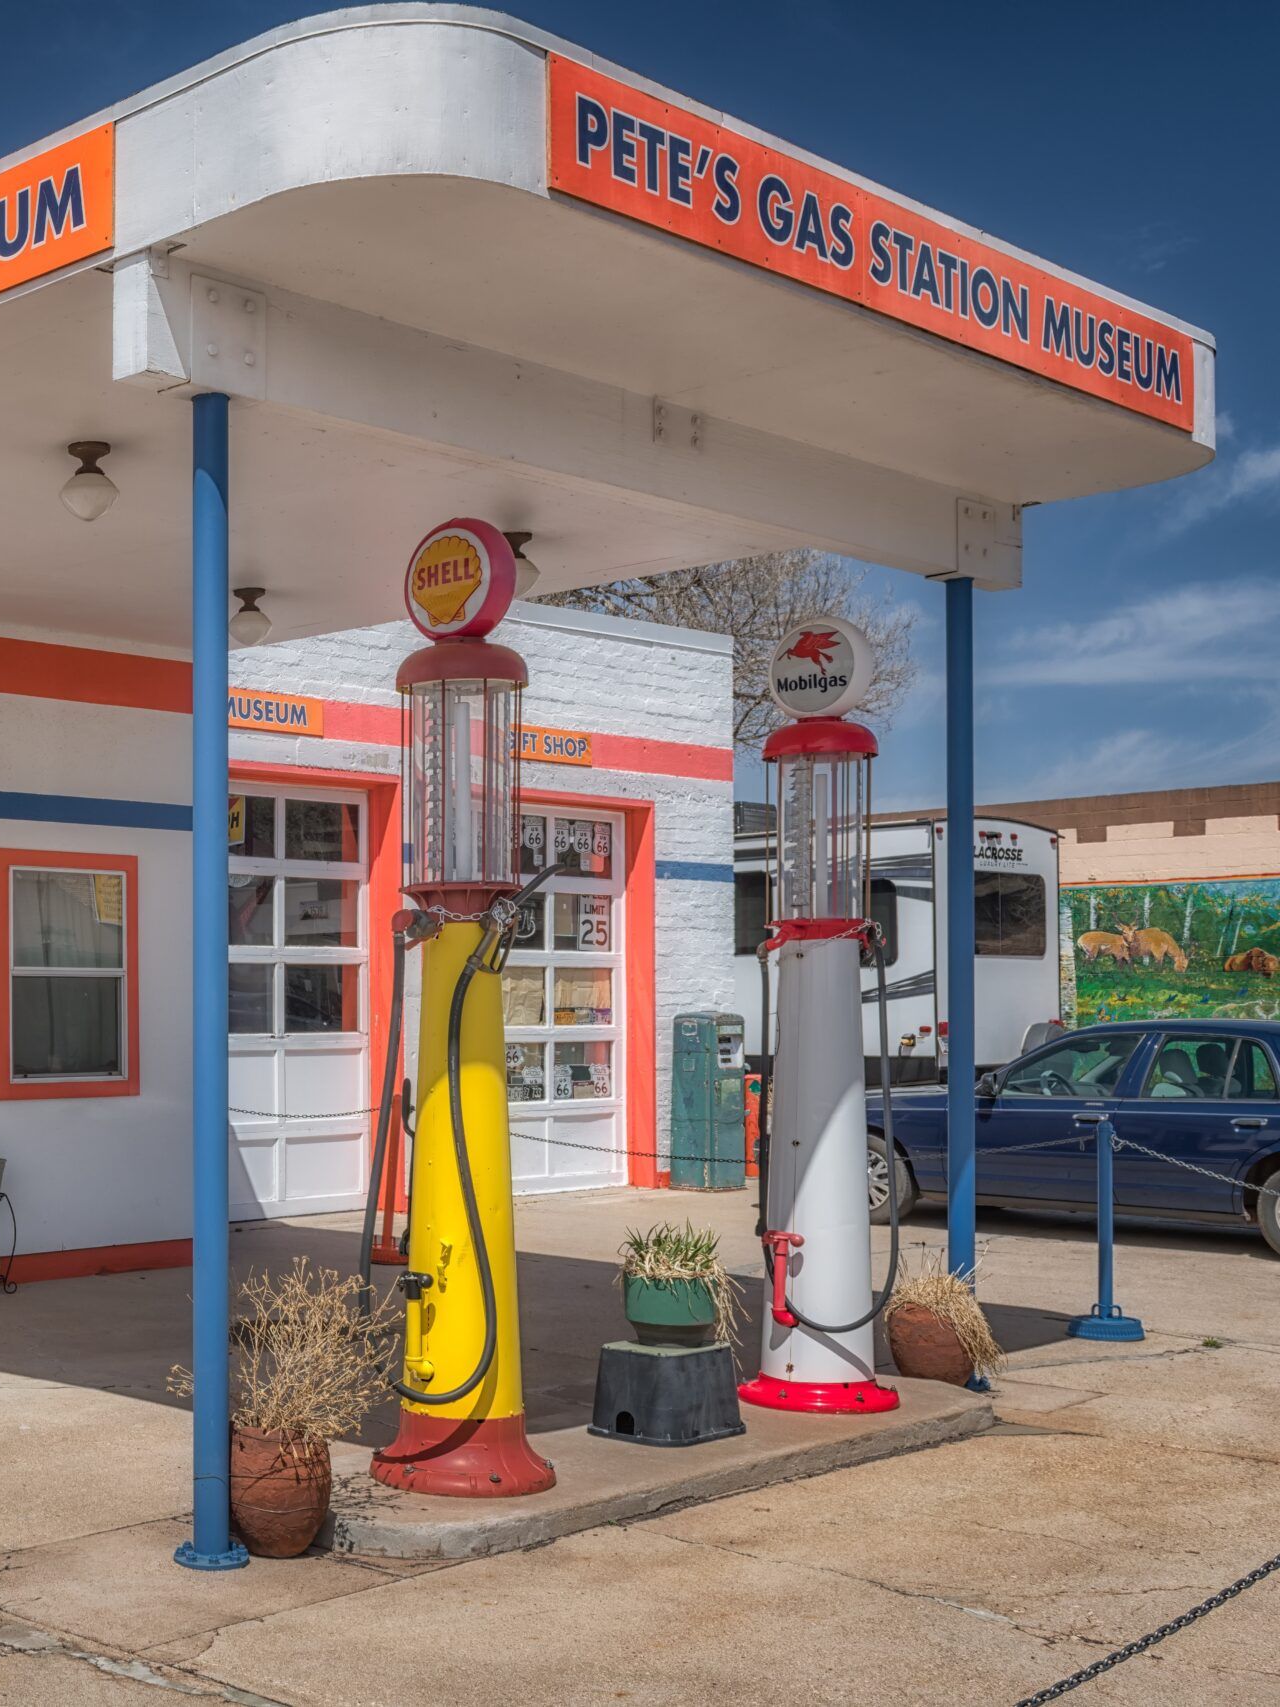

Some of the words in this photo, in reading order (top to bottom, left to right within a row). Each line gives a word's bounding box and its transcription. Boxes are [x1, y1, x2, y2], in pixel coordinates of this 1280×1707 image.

[577, 95, 741, 223] PETE'S
[757, 175, 855, 268] GAS
[869, 221, 1029, 342] STATION
[1042, 297, 1182, 403] MUSEUM
[417, 558, 475, 590] SHELL
[777, 674, 847, 693] Mobilgas
[543, 735, 587, 758] SHOP
[528, 833, 542, 845] 66
[554, 836, 567, 848] 66
[577, 838, 590, 850] 66
[596, 841, 608, 853] 66
[973, 846, 1023, 861] LACROSSE
[584, 903, 605, 915] LIMIT
[581, 919, 608, 946] 25
[506, 1051, 519, 1063] 66
[556, 1084, 570, 1096] 66
[594, 1082, 608, 1094] 66
